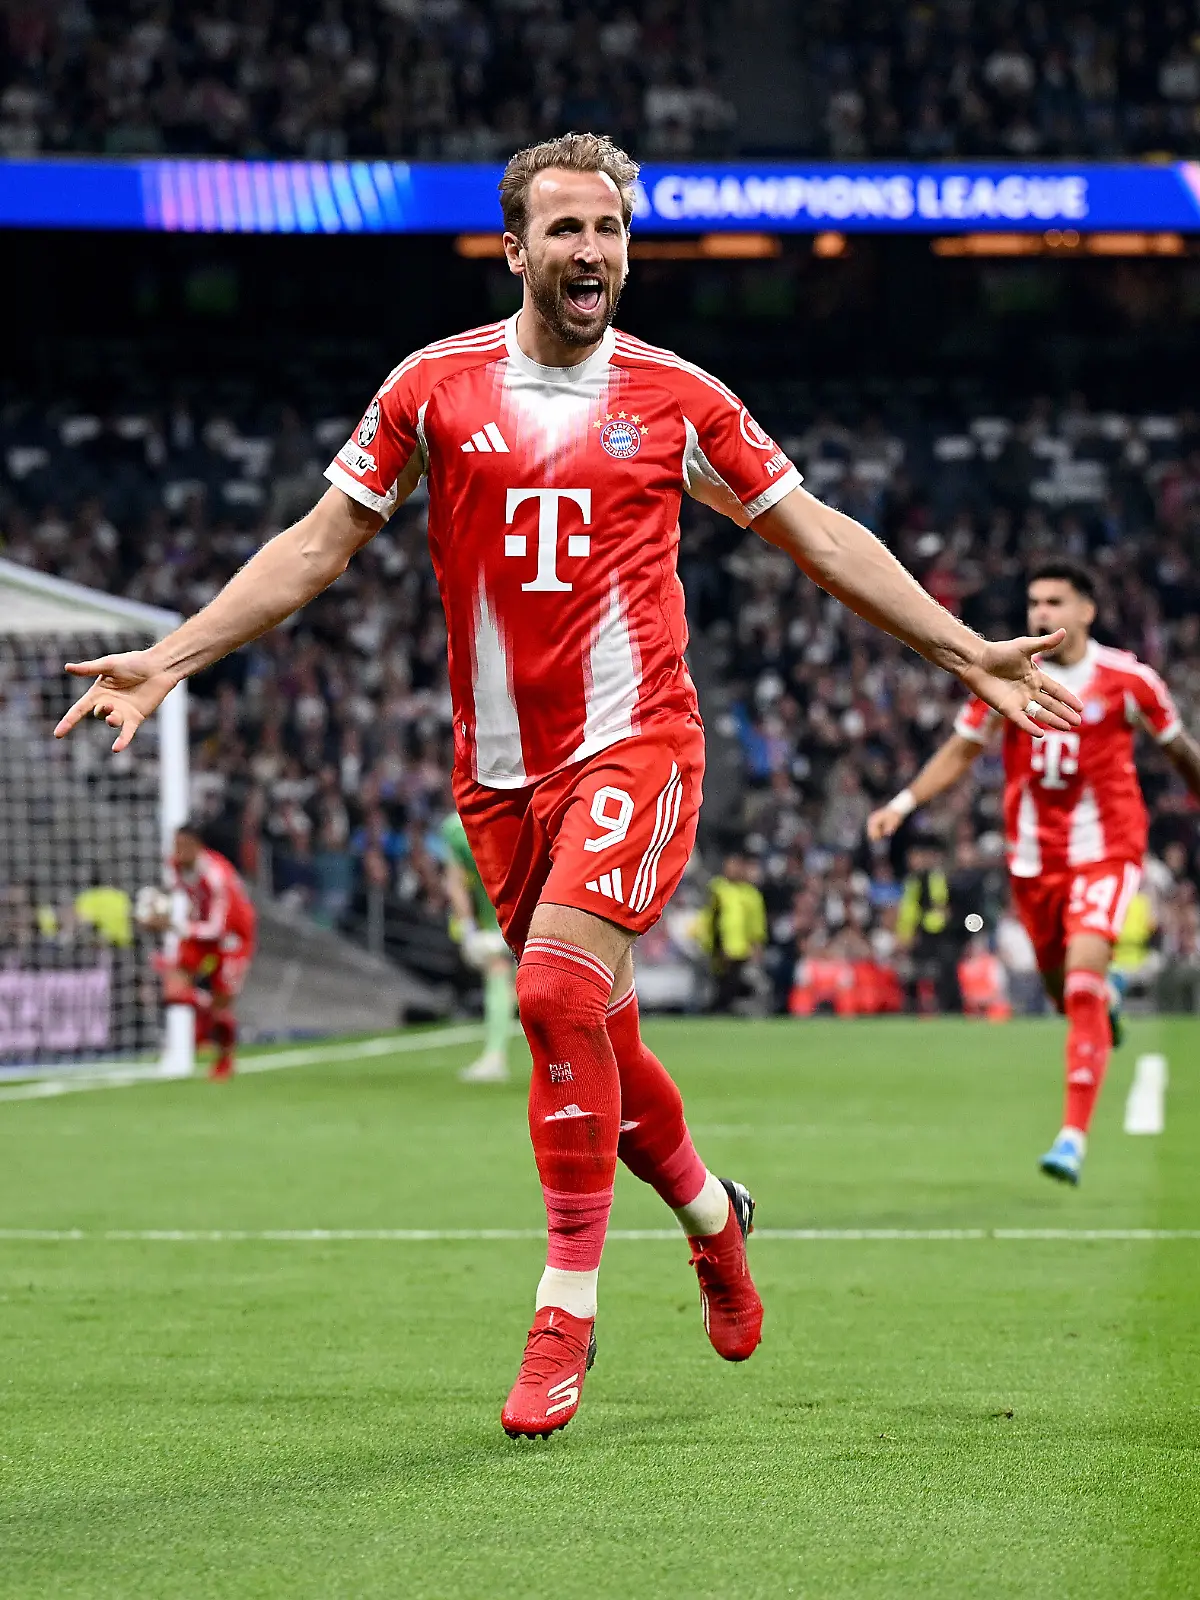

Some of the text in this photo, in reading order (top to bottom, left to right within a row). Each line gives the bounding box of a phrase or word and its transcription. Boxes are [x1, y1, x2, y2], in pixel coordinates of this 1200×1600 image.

[653, 174, 915, 219] CHAMPIONS
[917, 174, 1089, 219] LEAGUE
[504, 488, 591, 592] T
[1030, 733, 1080, 790] T
[583, 785, 635, 853] 9
